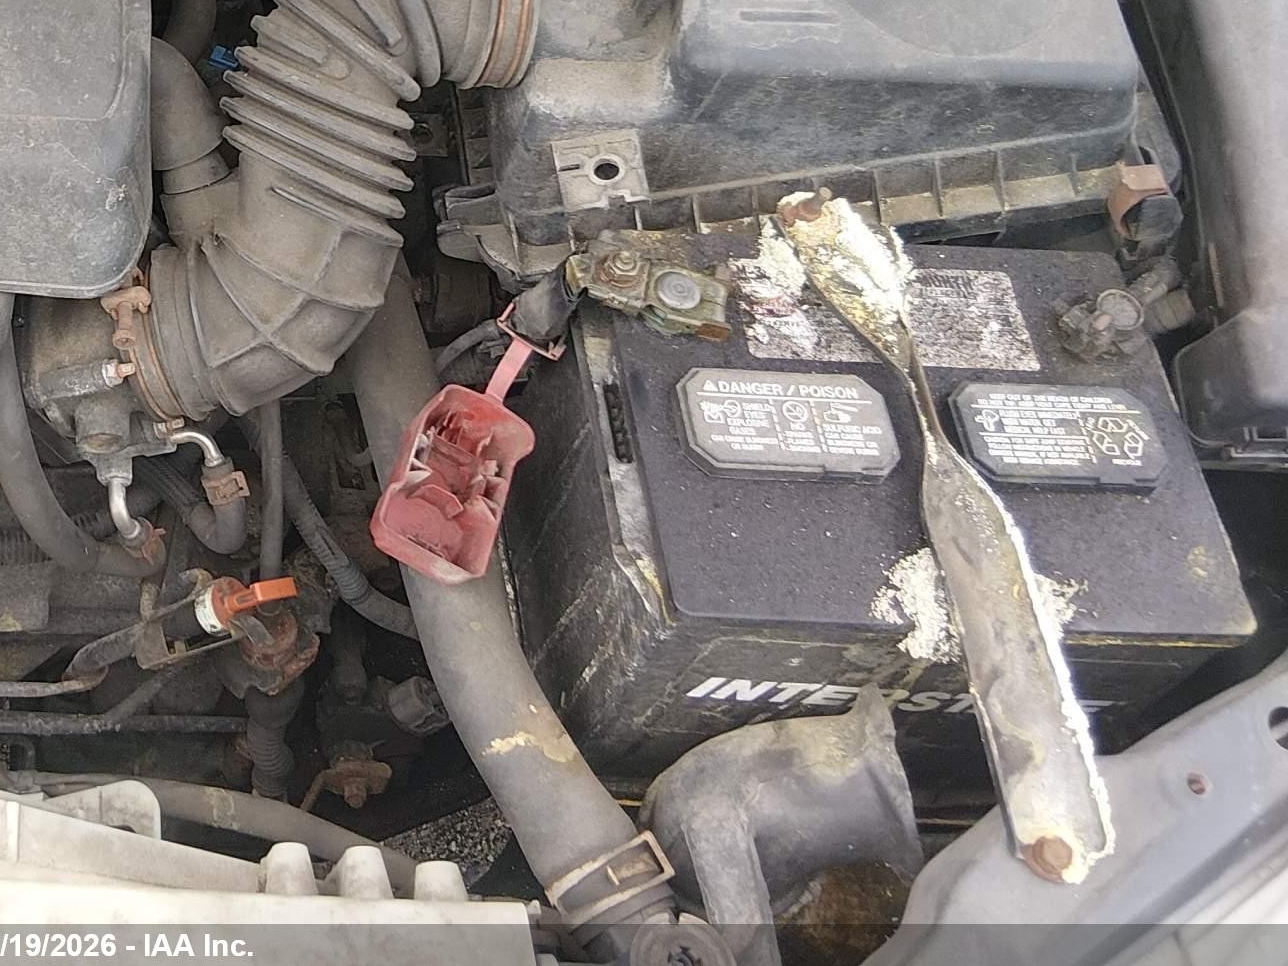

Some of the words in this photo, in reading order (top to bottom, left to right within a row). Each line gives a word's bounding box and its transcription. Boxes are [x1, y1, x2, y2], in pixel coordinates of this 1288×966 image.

[718, 381, 784, 396] DANGER
[786, 385, 796, 396] /
[798, 385, 859, 399] POISON
[686, 676, 1113, 713] INTEST
